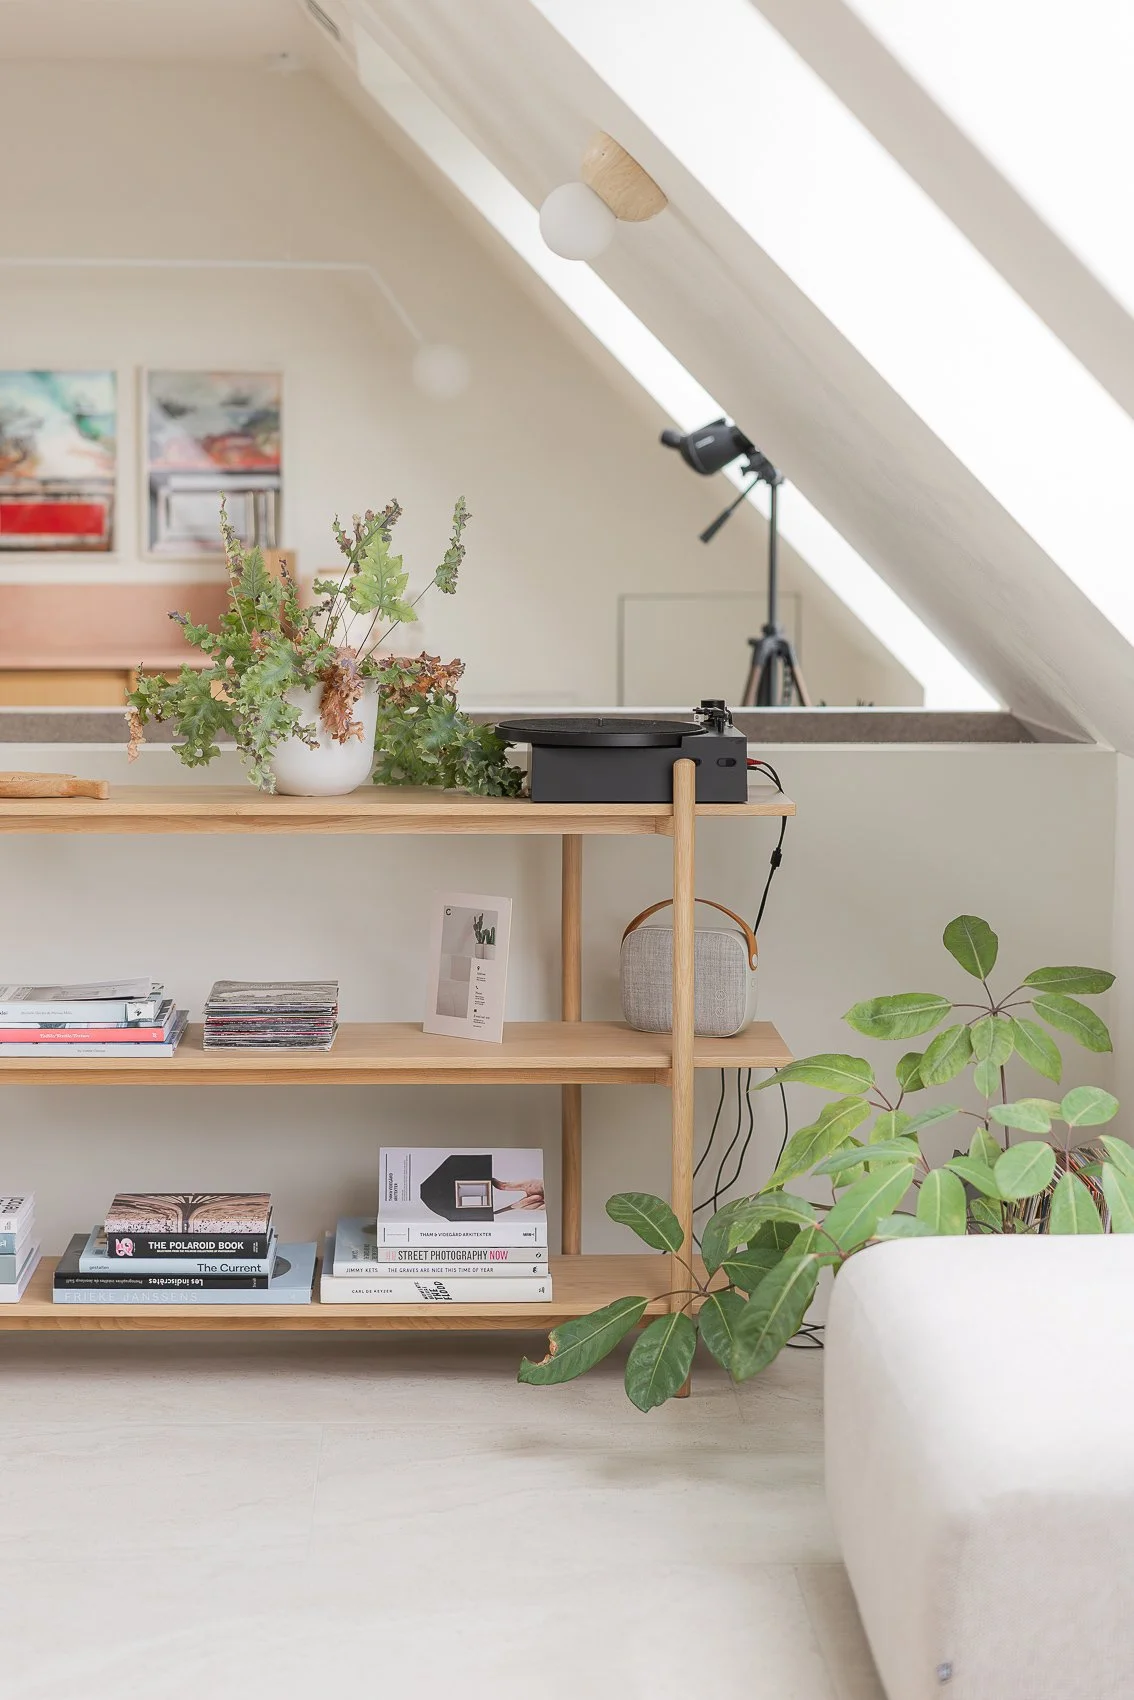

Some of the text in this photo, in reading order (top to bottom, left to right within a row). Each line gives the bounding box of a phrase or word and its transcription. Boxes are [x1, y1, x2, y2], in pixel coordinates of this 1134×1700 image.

[445, 908, 452, 916] C
[148, 1241, 167, 1250] THE
[169, 1241, 216, 1250] POLAROID
[218, 1241, 245, 1250] BOOK
[398, 1250, 428, 1260] STREET
[430, 1250, 488, 1260] PHOTOGRAPHY
[489, 1250, 509, 1260] NOW
[197, 1263, 262, 1273] The Current
[149, 1278, 204, 1286] Les indiscrètes
[64, 1292, 198, 1302] FRIEKE JANSSENS
